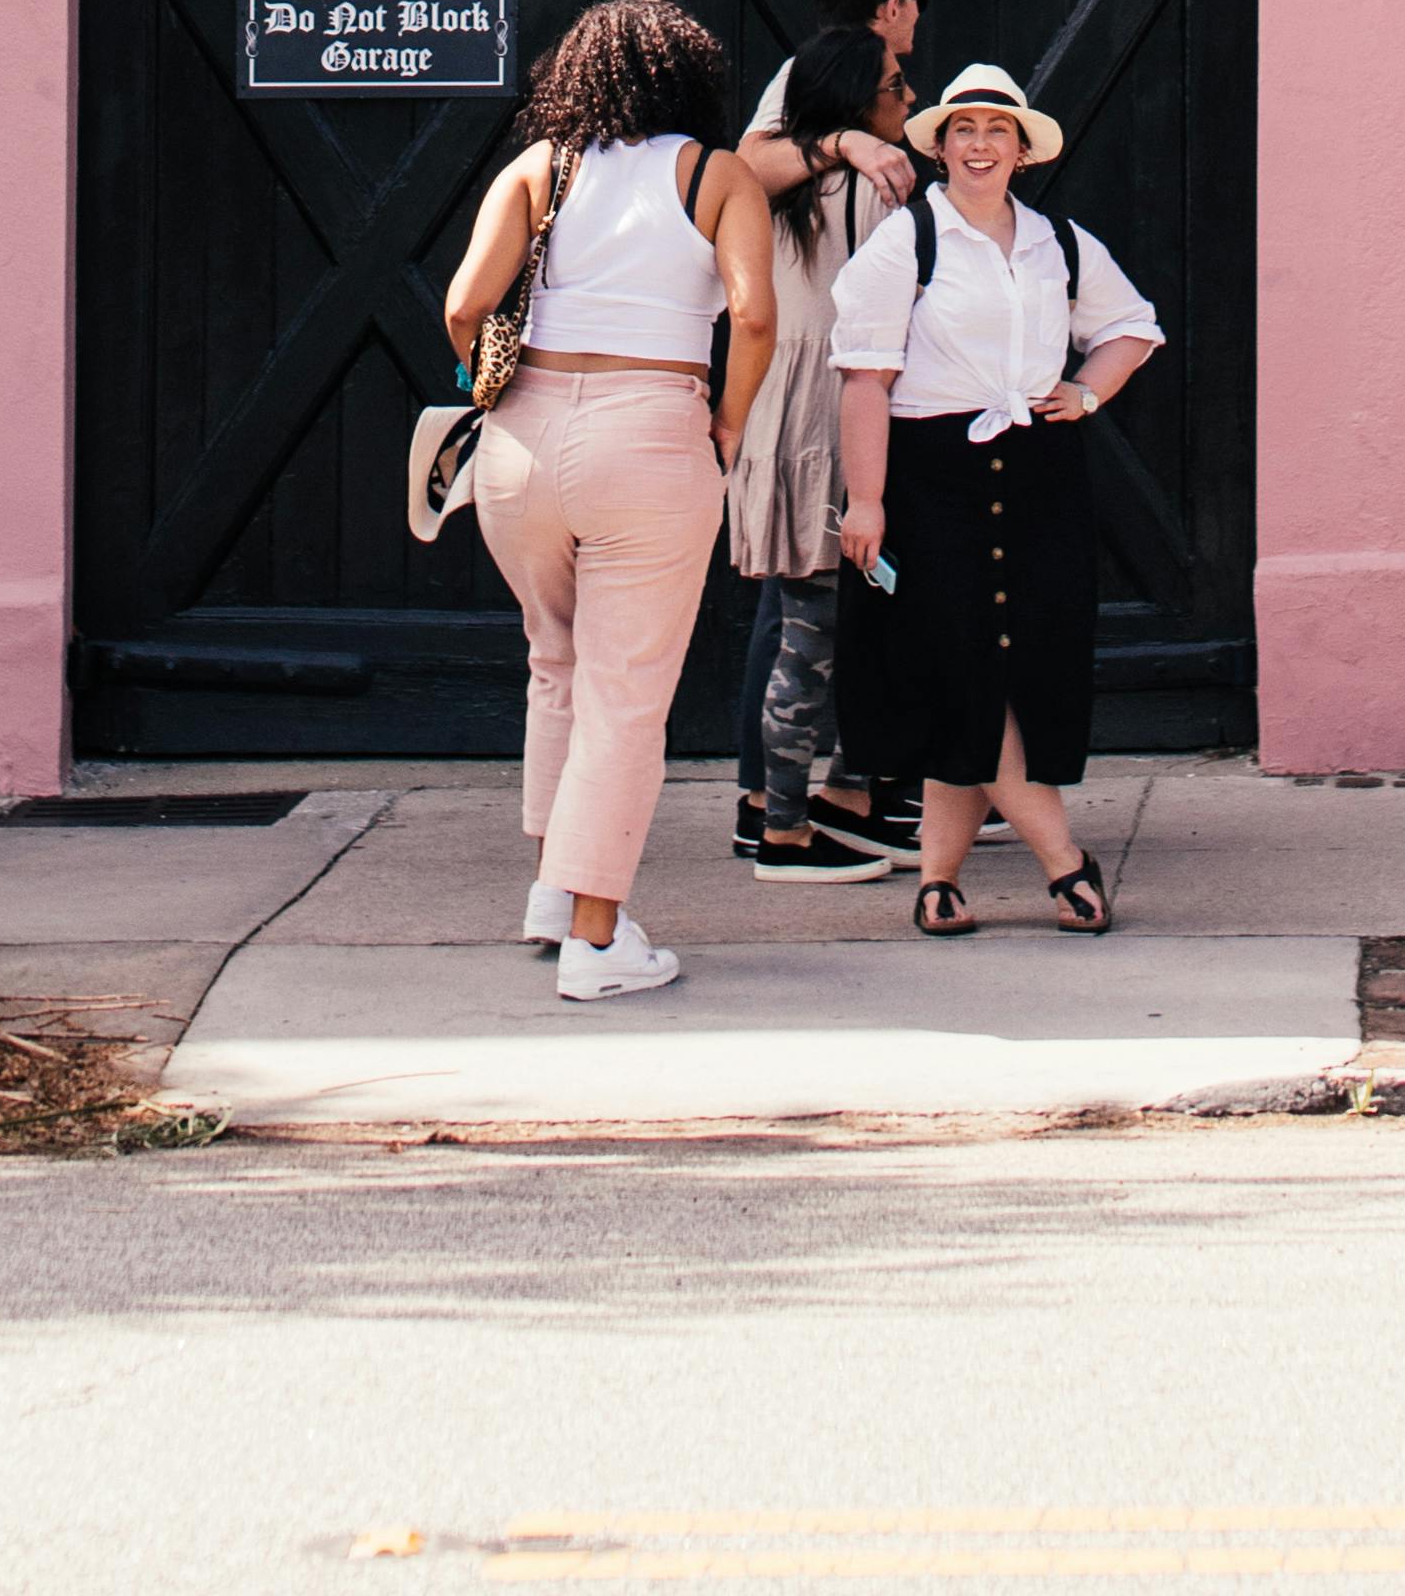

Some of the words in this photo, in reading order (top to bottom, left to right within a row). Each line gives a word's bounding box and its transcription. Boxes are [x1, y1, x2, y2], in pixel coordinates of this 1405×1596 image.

[264, 2, 314, 34] Do
[323, 2, 387, 35] Not
[398, 1, 490, 36] Block
[321, 41, 432, 76] Garage
